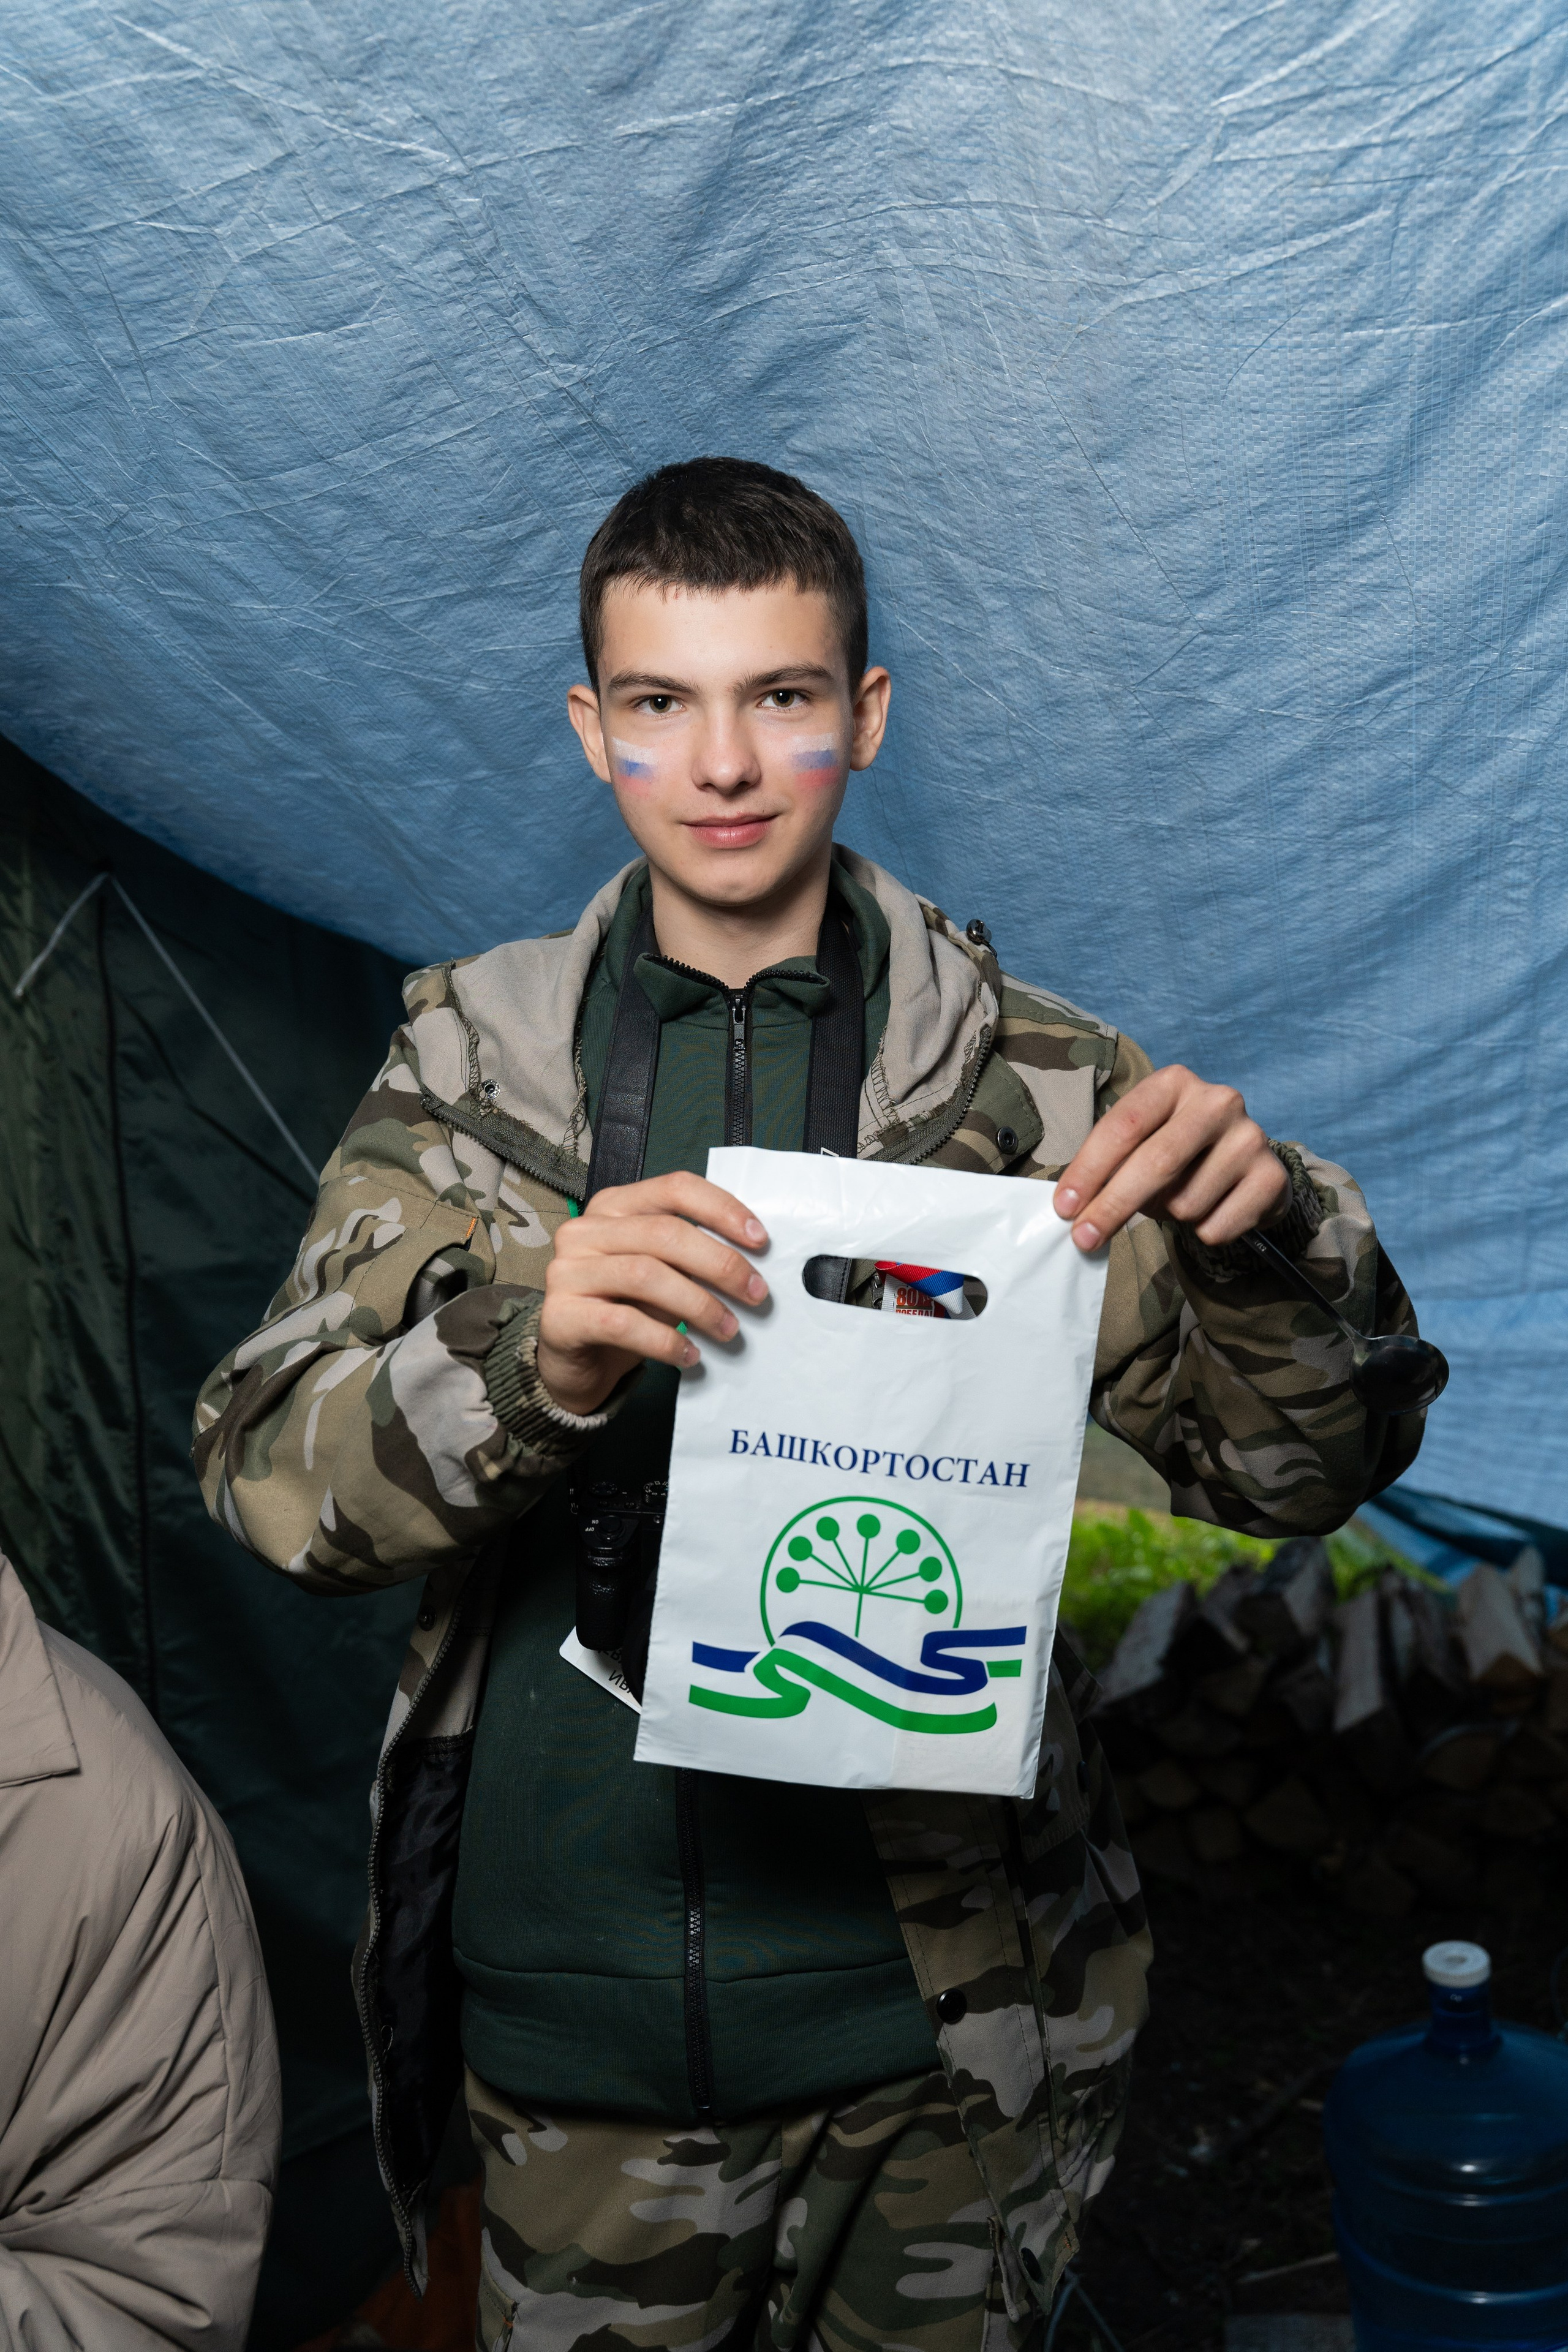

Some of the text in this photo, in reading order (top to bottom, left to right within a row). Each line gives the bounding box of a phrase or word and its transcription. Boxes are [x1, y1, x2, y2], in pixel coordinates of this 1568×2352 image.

[896, 1287, 918, 1306] 80
[731, 1430, 1030, 1487] БАШКОРТОСТАН
[608, 1670, 631, 1694] ИВ
